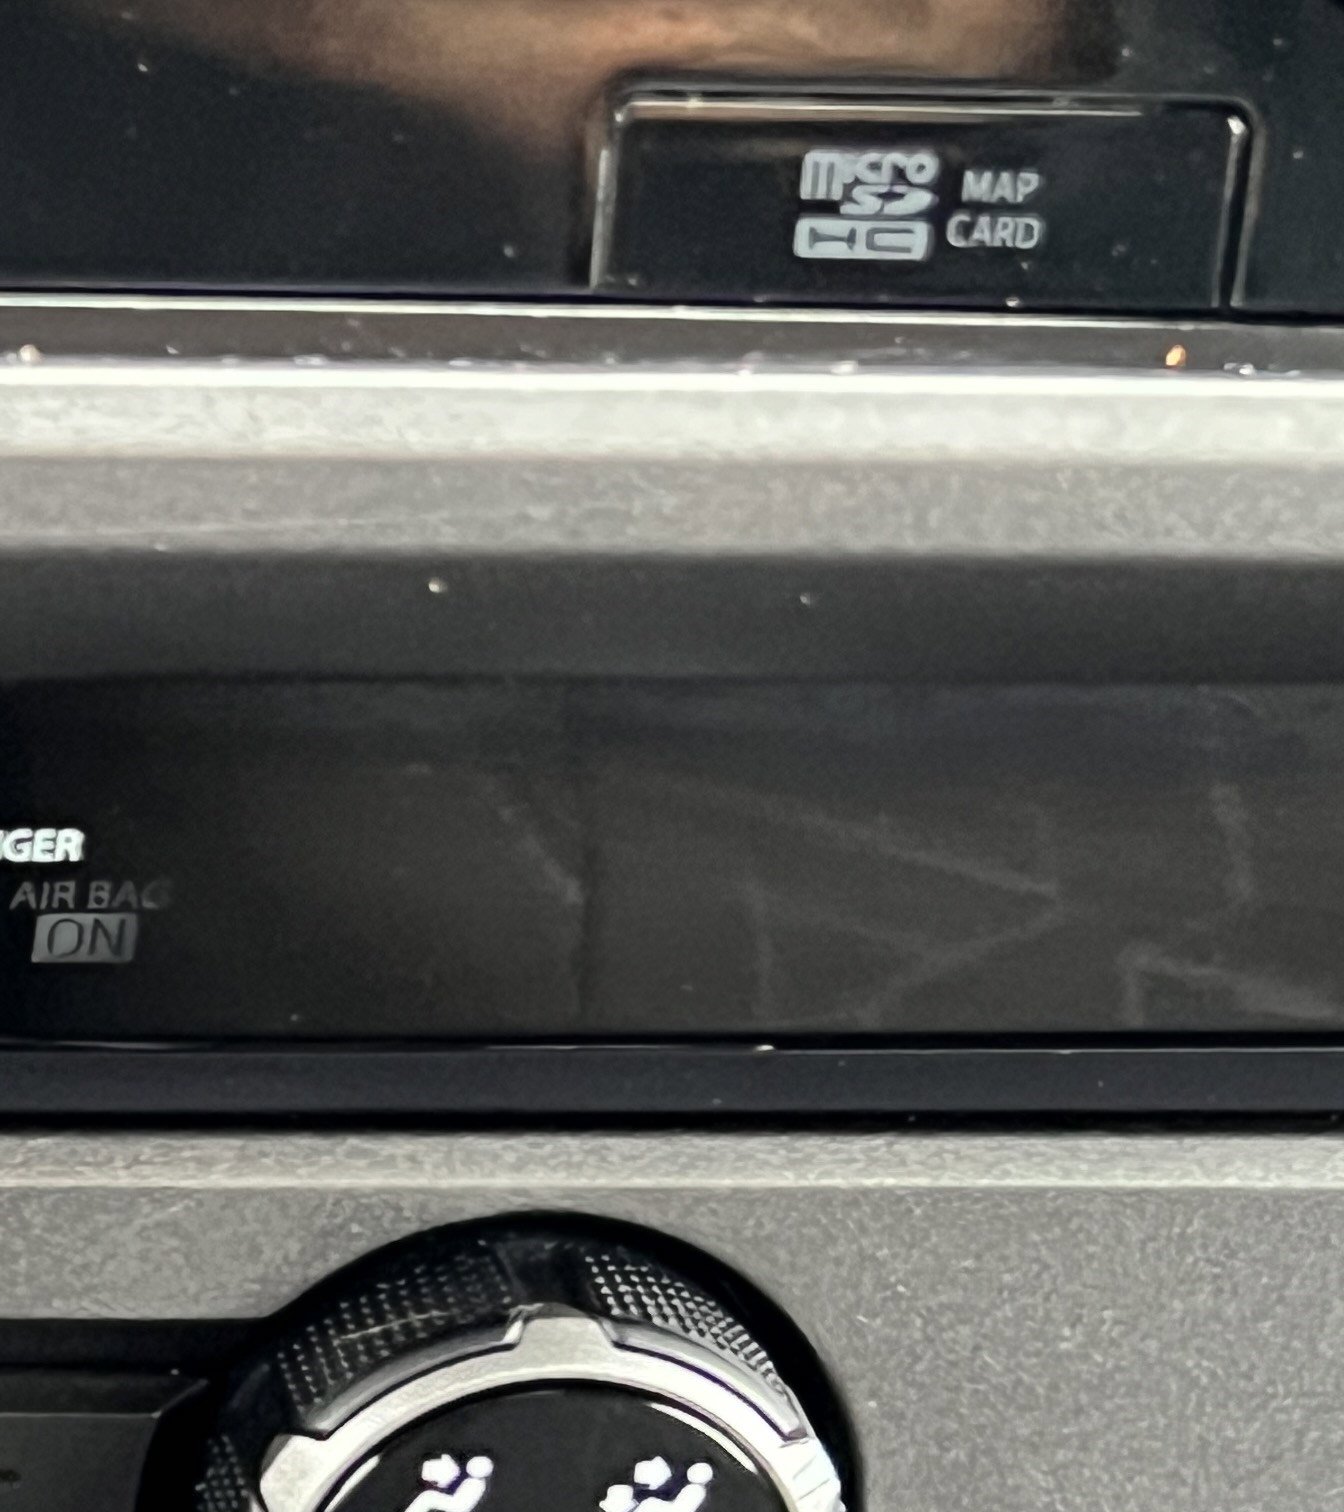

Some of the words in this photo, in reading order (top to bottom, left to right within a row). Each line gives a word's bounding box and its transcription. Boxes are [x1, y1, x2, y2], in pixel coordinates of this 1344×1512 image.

[962, 170, 1040, 203] MAP
[946, 213, 1043, 249] CARD
[9, 880, 77, 911] AIR
[46, 916, 128, 960] ON
